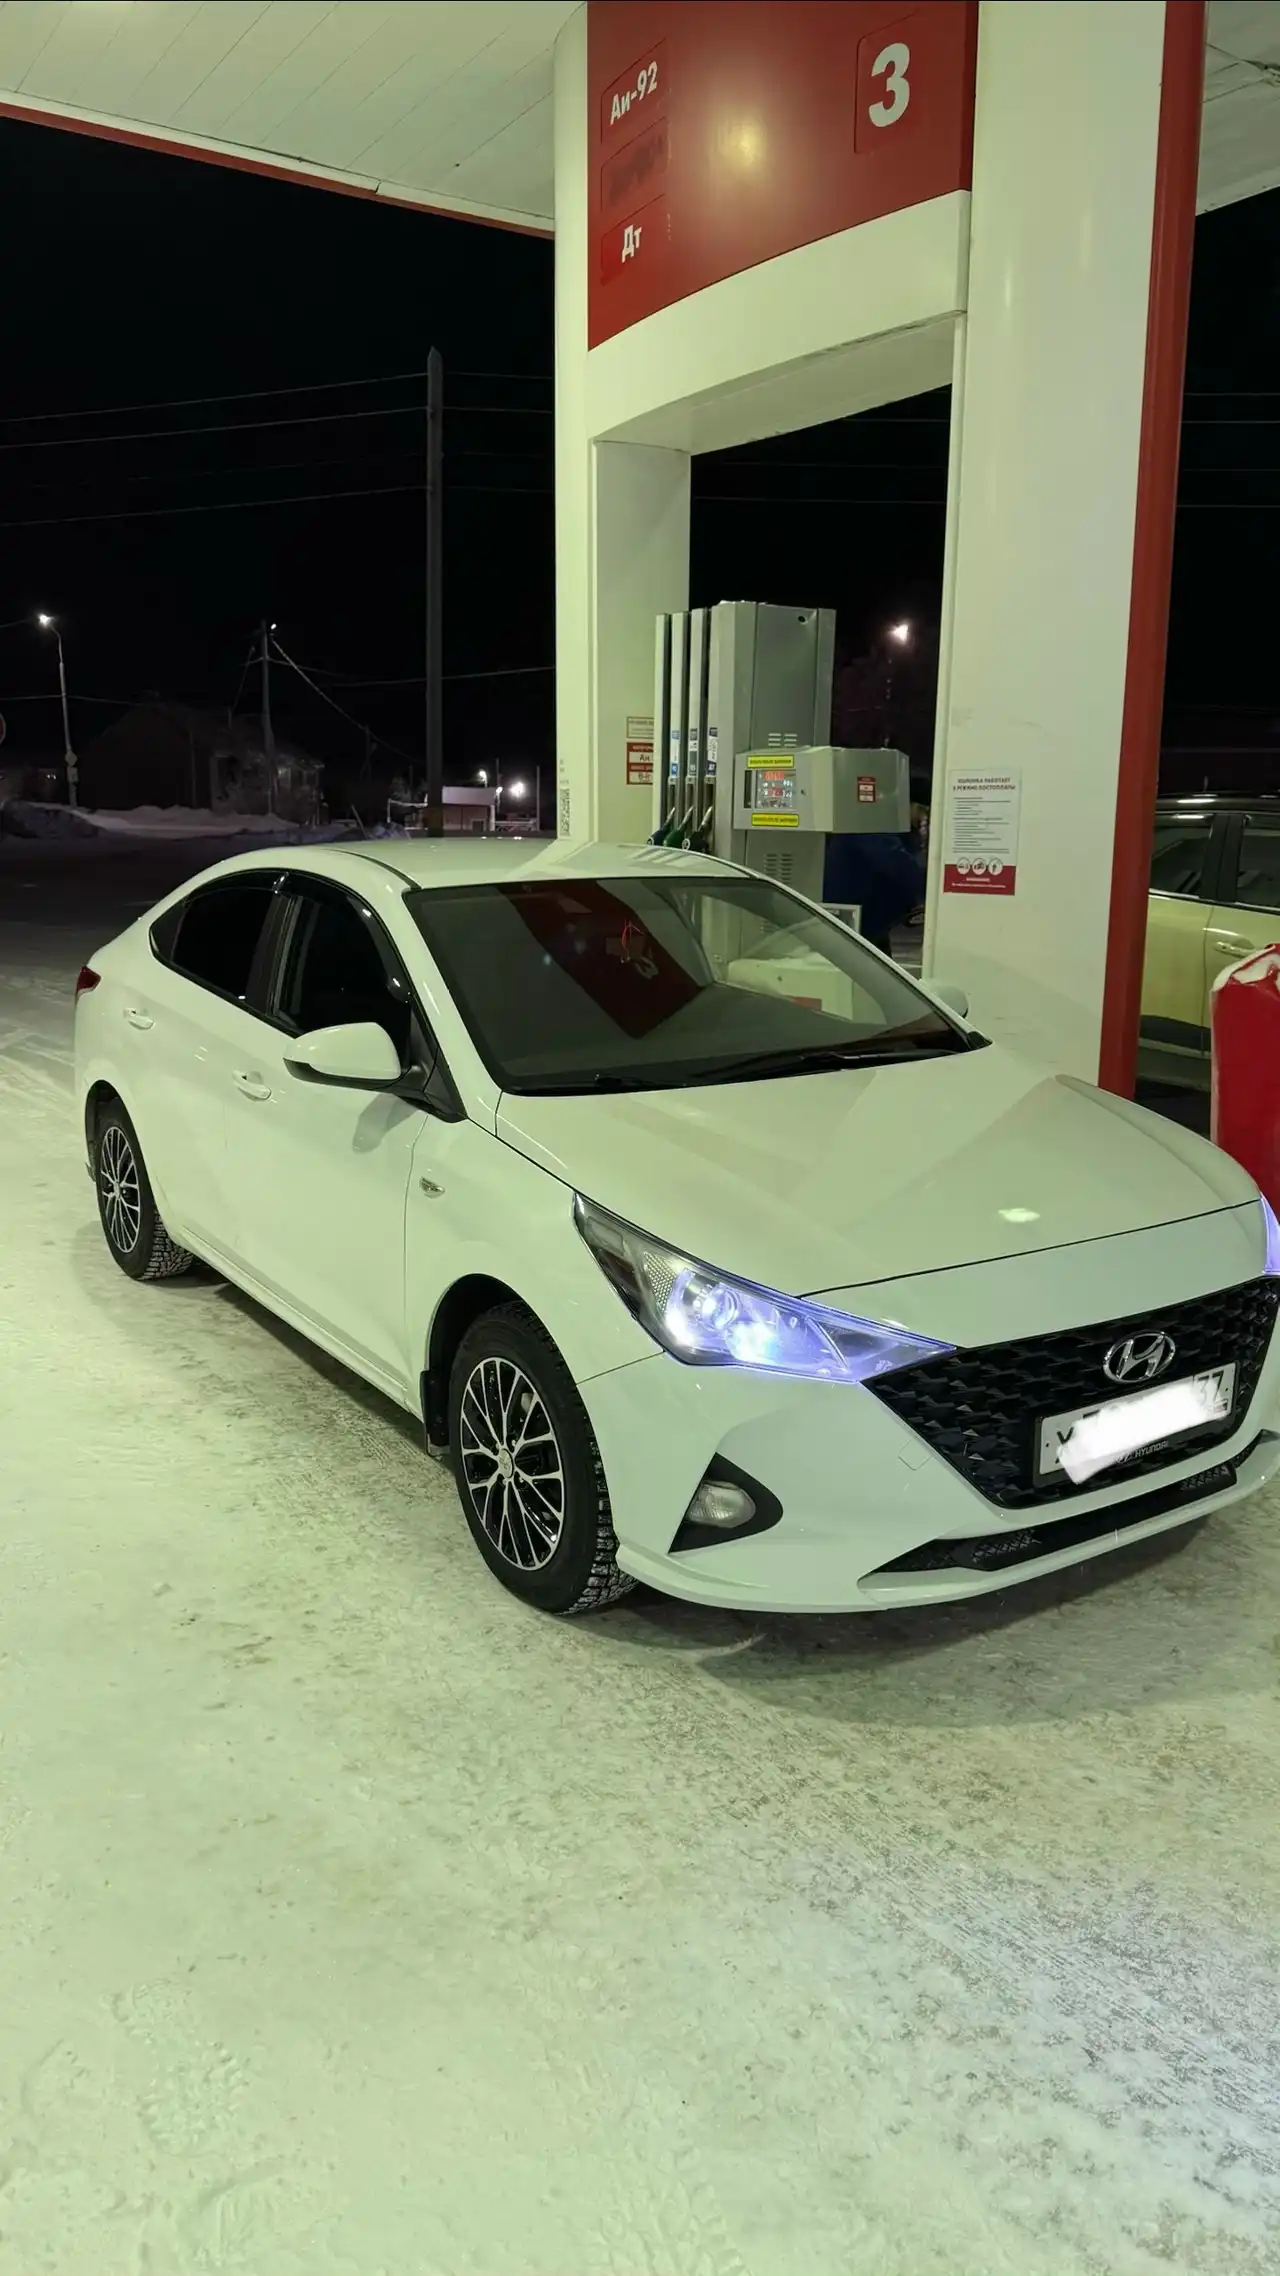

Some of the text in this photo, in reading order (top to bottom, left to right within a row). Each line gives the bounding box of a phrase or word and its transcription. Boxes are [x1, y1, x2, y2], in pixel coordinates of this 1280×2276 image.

[610, 61, 658, 126] Аи-92
[869, 42, 910, 127] 3
[621, 224, 642, 264] Дт
